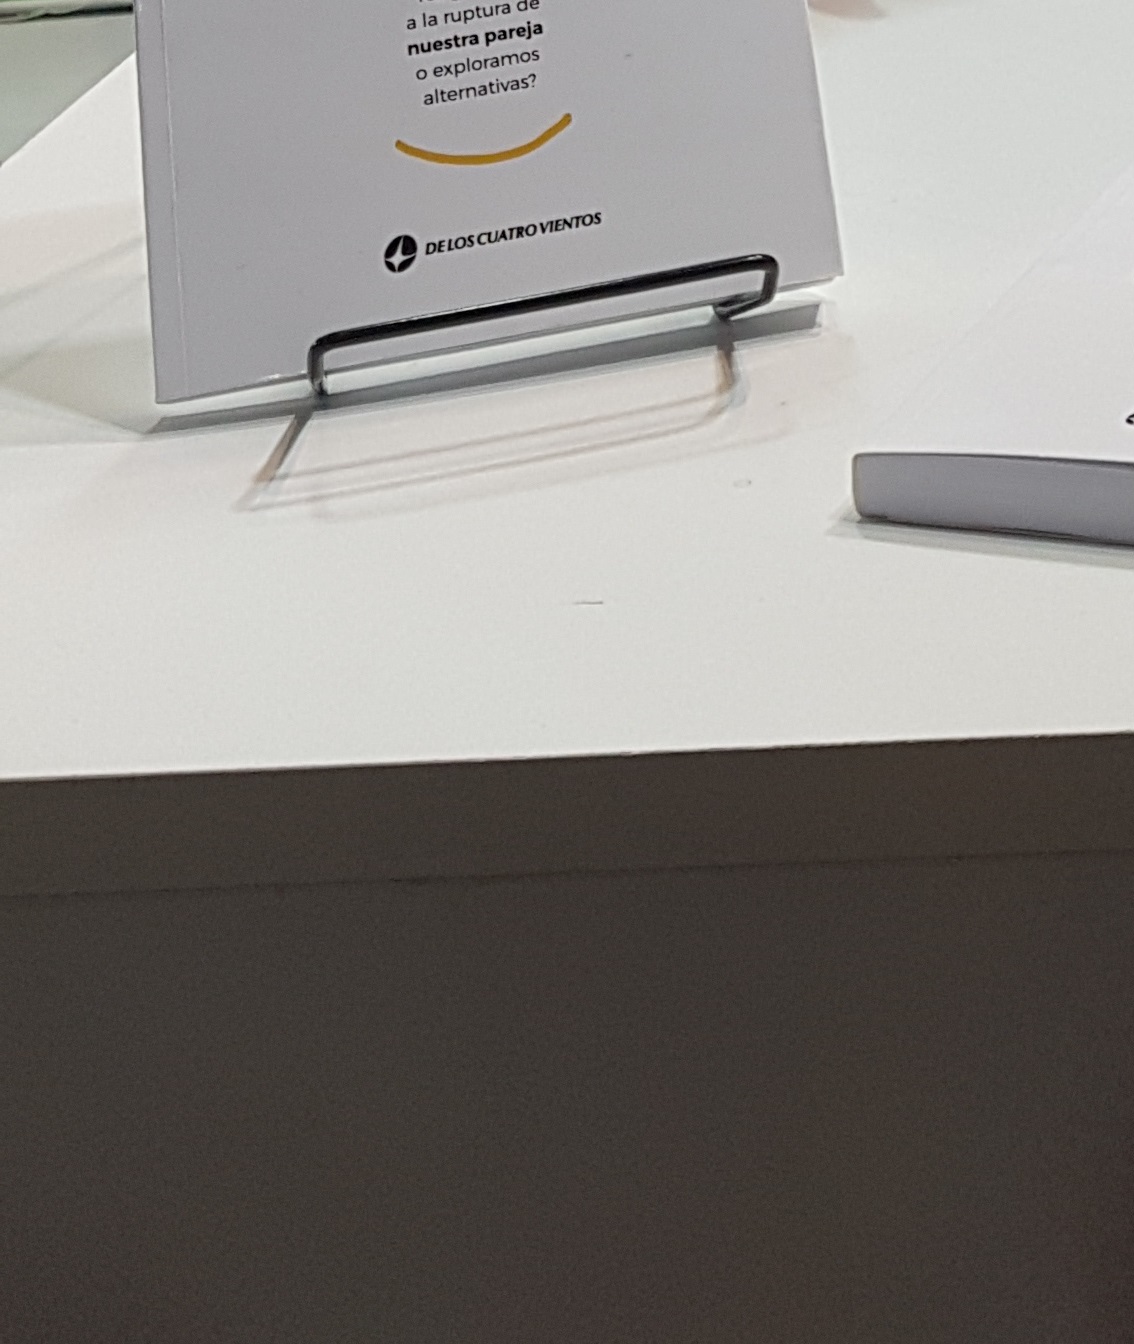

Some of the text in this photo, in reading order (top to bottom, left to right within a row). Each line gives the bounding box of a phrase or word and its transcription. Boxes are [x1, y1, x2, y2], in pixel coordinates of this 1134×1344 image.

[406, 18, 417, 30] a
[423, 12, 438, 28] la
[444, 2, 511, 24] ruptura
[407, 21, 544, 56] nuestra pareja
[415, 49, 540, 81] o exploramos
[423, 73, 537, 106] alternativas?
[425, 212, 603, 256] DE LOS CUATRO VIENTOS
